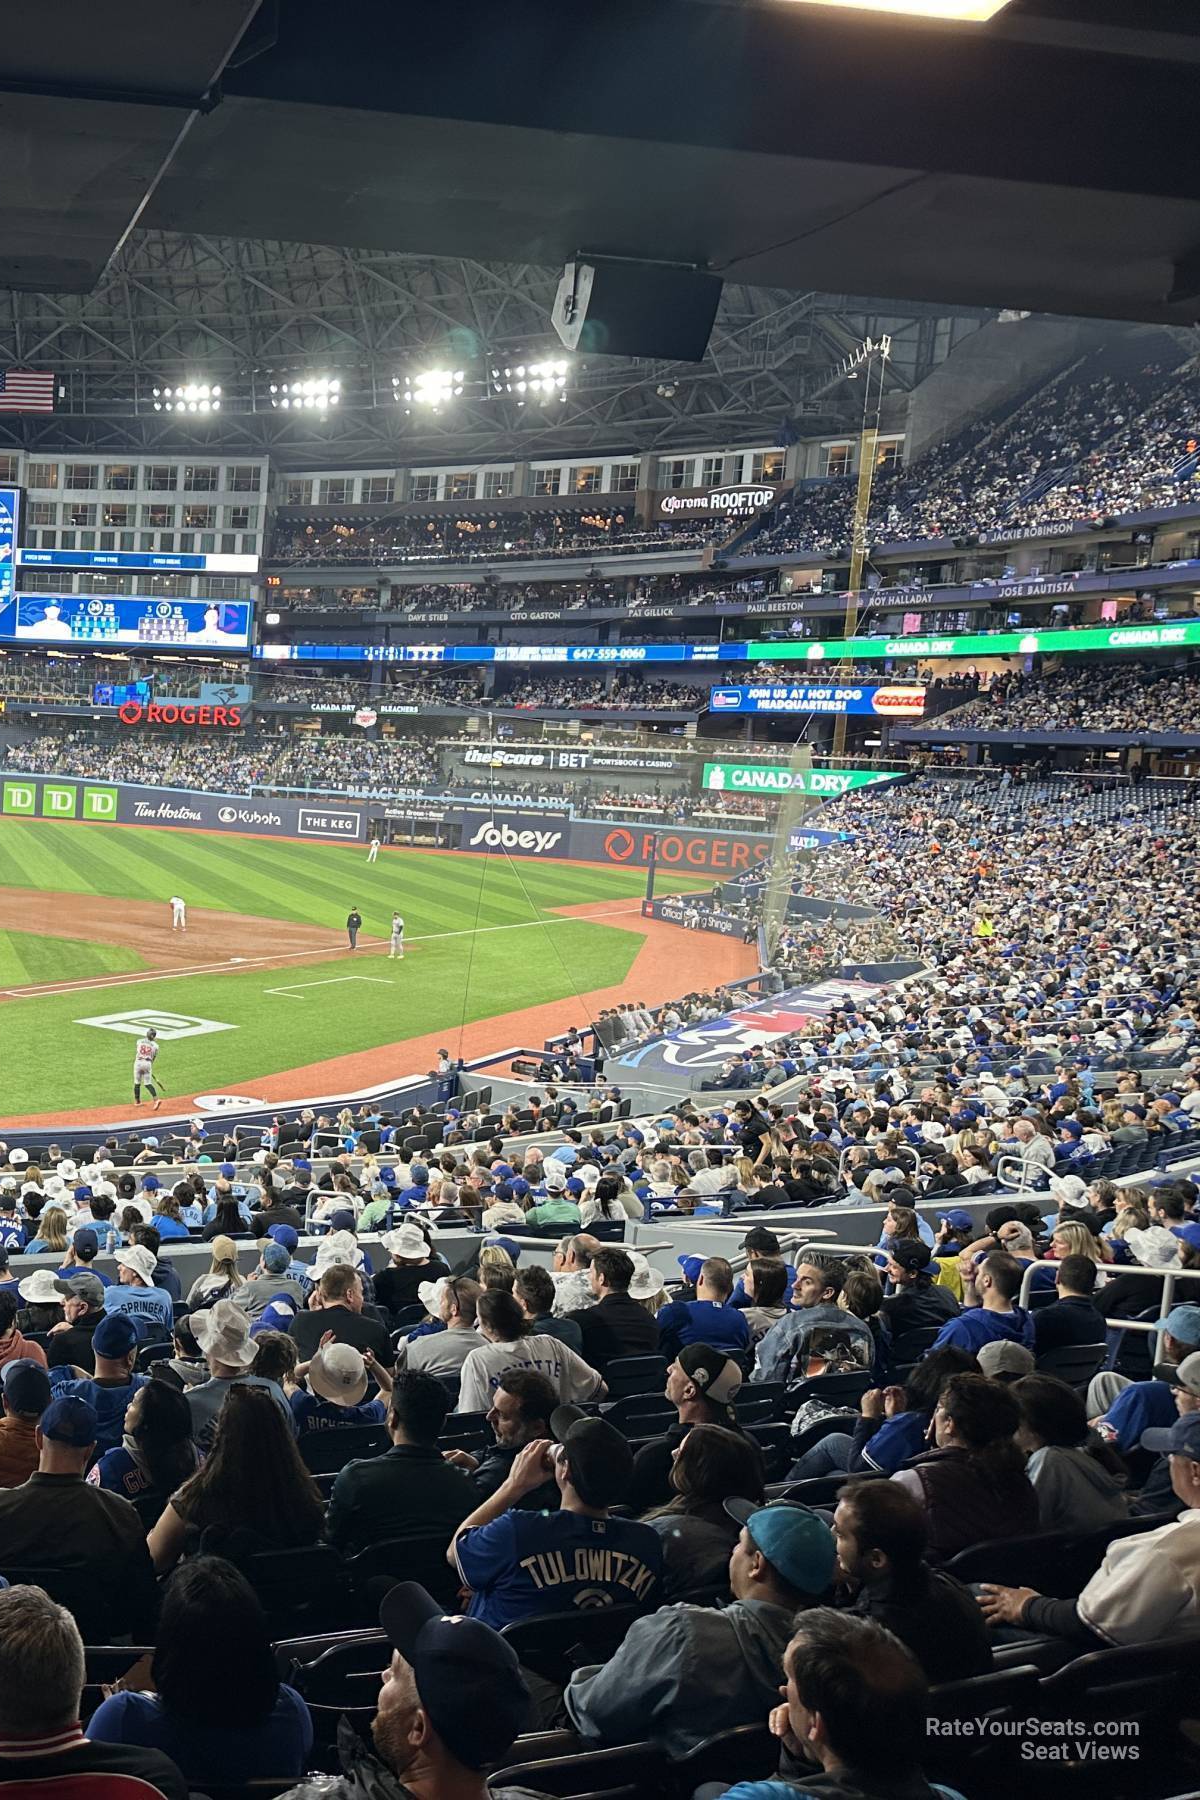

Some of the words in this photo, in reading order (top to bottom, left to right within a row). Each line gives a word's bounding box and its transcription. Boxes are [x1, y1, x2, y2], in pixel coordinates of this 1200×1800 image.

[660, 496, 708, 514] Corona
[710, 490, 774, 509] ROOFTOP
[726, 507, 754, 516] PATIO
[990, 528, 1022, 542] JACKIE
[1023, 522, 1074, 538] ROBINSON
[998, 583, 1024, 598] JOSÉ
[1026, 583, 1074, 596] BAUTISTA
[79, 603, 85, 611] 9
[747, 604, 766, 613] PAUL
[767, 602, 804, 612] BEESTON
[868, 596, 887, 608] ROY
[888, 594, 934, 606] HALLADAY
[147, 605, 152, 613] 5
[174, 605, 182, 614] 12
[510, 612, 527, 621] CITO
[530, 612, 560, 620] GASTON
[628, 609, 643, 618] PAT
[643, 608, 674, 617] GILLICK
[408, 614, 426, 622] DAVE
[1108, 630, 1158, 645] CANADA
[1160, 627, 1188, 642] DRY
[573, 648, 646, 660] 647-559-0060
[885, 642, 929, 654] CANADA
[930, 640, 955, 653] DRY
[747, 689, 770, 700] JOIN
[772, 689, 787, 700] US
[790, 689, 805, 700] AT
[807, 689, 833, 700] HOT
[834, 689, 863, 701] DOG
[310, 703, 340, 712] CANADA
[341, 704, 356, 712] DRY
[757, 700, 847, 712] HEADQUARTERS!
[146, 703, 242, 727] ROGERS
[464, 749, 544, 766] theScore
[558, 752, 588, 769] BET
[592, 758, 638, 768] SPORTSBOOK
[645, 760, 673, 769] CASINO
[731, 770, 805, 790] CANADA
[810, 774, 853, 792] DRY
[8, 788, 32, 808] TD
[47, 790, 72, 811] TD
[88, 793, 114, 813] TD
[470, 792, 532, 805] CANADA
[538, 795, 569, 808] DRY
[134, 801, 156, 818] Tim
[156, 802, 202, 821] Hortons
[238, 810, 281, 826] Kubota
[384, 808, 404, 816] Active
[306, 817, 327, 828] THE
[331, 819, 352, 830] KEG
[470, 822, 562, 853] Sobeys
[790, 835, 808, 846] MAY
[642, 834, 769, 869] ROGERS
[661, 906, 683, 920] Official
[708, 916, 732, 932] Shingle
[140, 1044, 152, 1056] 82
[120, 1301, 164, 1315] SPRINGER
[519, 1548, 656, 1601] TULOWITZKI
